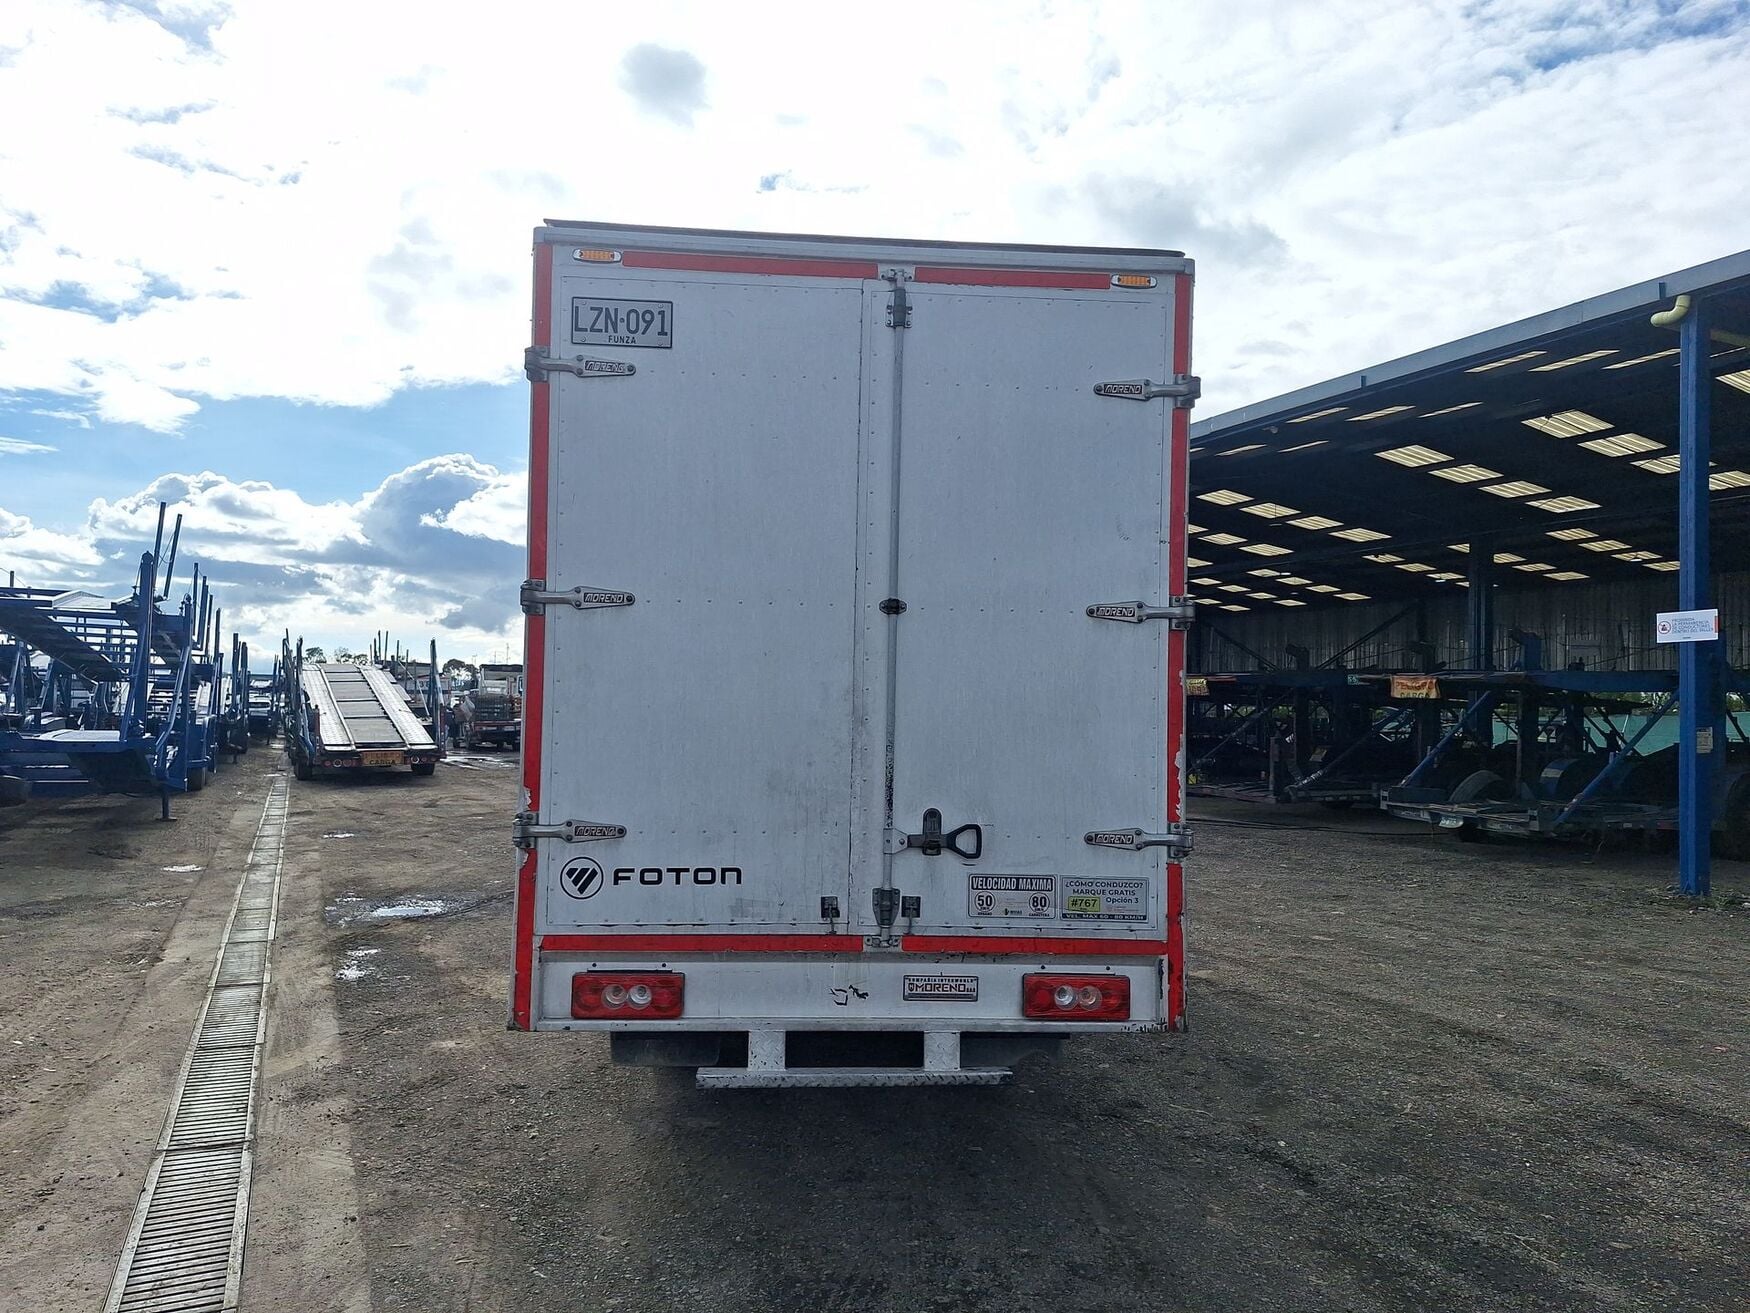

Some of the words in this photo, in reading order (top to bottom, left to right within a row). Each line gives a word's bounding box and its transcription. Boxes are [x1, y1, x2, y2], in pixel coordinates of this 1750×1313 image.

[608, 335, 637, 344] FUNZA
[1105, 384, 1141, 394] MORENO
[585, 593, 624, 603] MORENO
[1097, 607, 1134, 617] MORENO
[576, 826, 616, 836] MORENO
[1095, 834, 1132, 844] MORENO
[613, 867, 742, 886] FOTON
[972, 877, 1017, 890] VELOCIDAD
[1018, 878, 1052, 891] MAXIMA
[1095, 881, 1143, 889] CONDUZCO?
[977, 894, 992, 906] 50
[1032, 895, 1046, 907] 80
[1070, 898, 1098, 907] #767
[1105, 896, 1133, 904] Opción
[915, 983, 966, 992] MORENO
